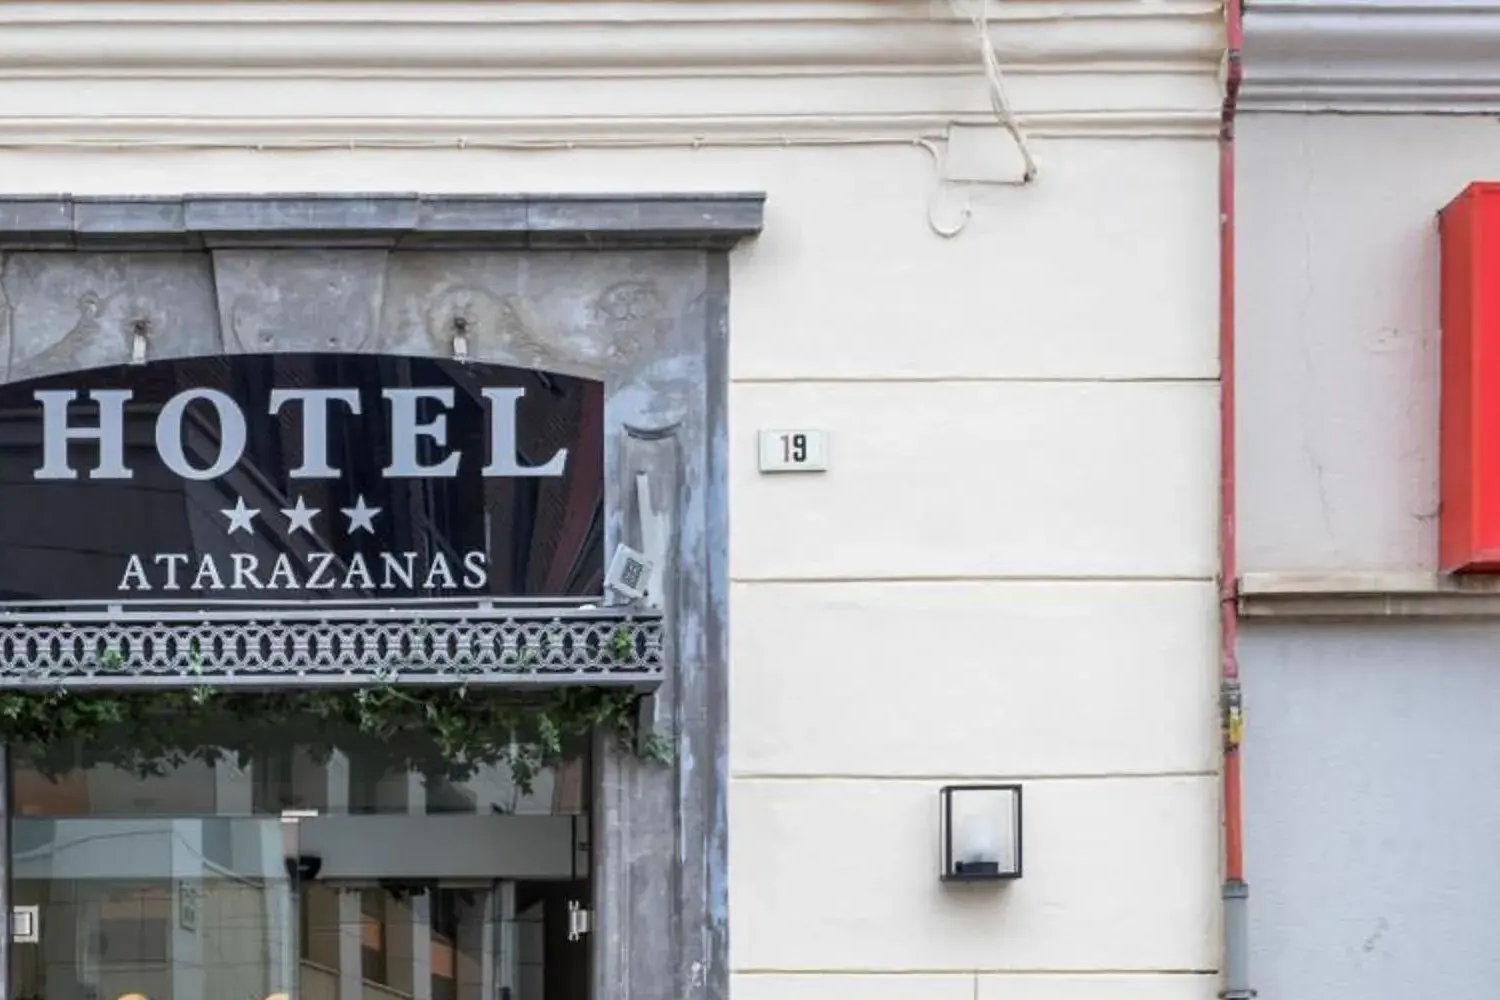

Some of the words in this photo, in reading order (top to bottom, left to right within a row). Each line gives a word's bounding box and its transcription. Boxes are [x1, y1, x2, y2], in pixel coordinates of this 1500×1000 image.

[33, 387, 568, 480] HOTEL
[780, 434, 806, 462] 19
[118, 552, 488, 589] ATARAZANAS
